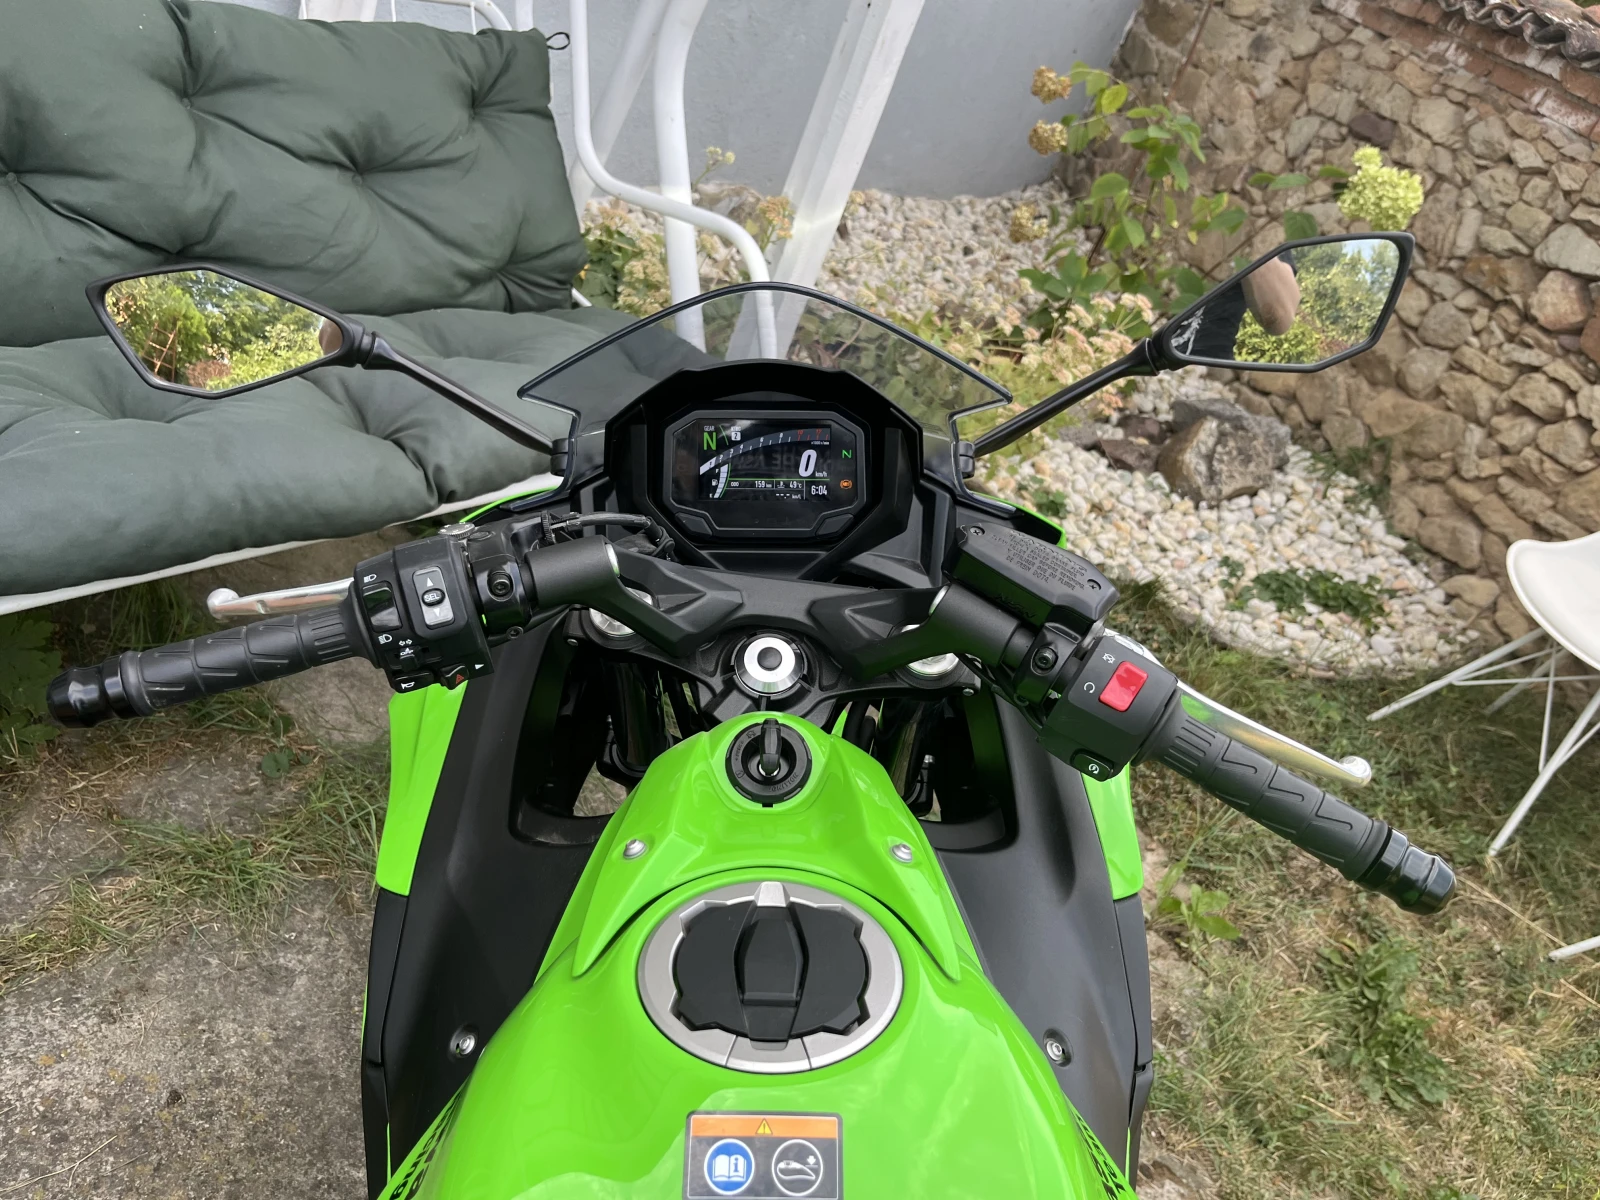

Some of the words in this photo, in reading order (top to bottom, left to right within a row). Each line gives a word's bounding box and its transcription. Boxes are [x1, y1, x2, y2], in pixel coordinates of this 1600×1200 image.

[703, 432, 717, 450] N
[842, 449, 852, 459] N
[799, 449, 817, 477] 0
[755, 480, 766, 488] 159
[811, 485, 828, 496] 6:04
[424, 592, 440, 602] SEL
